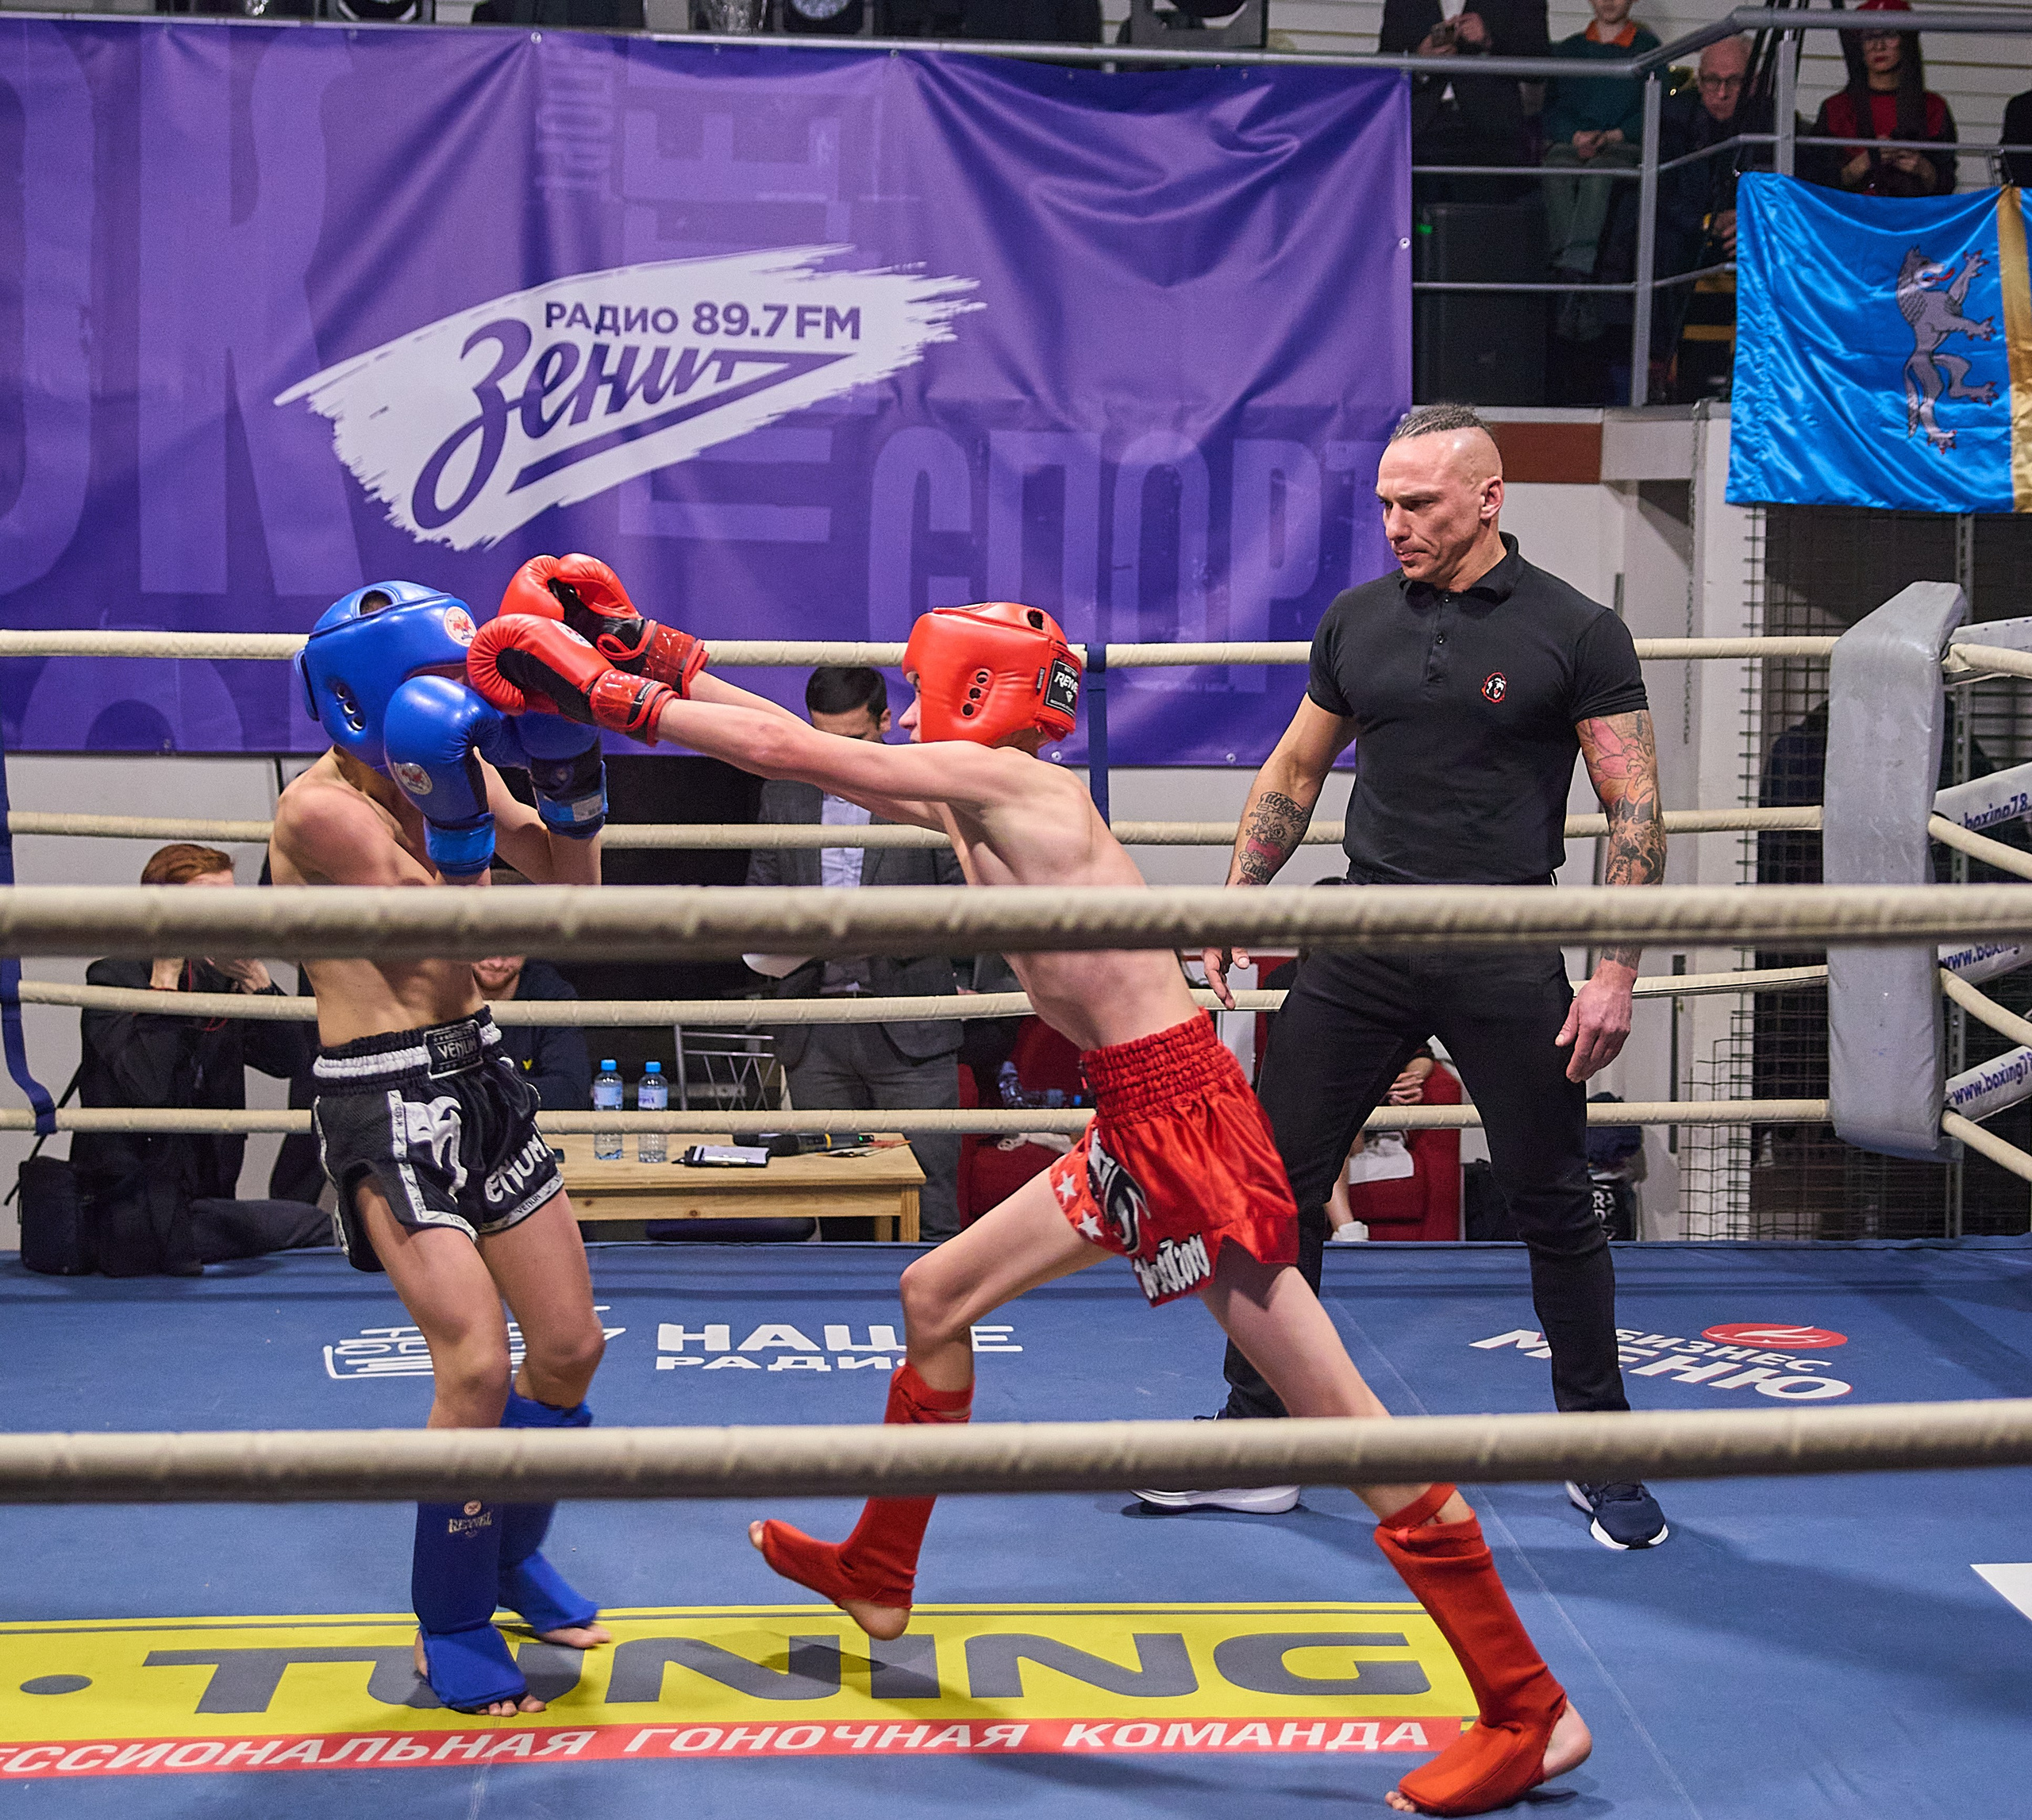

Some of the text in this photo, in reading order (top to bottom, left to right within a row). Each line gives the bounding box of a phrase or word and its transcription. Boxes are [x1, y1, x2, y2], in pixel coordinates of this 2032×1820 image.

[545, 302, 679, 337] РАДИО
[411, 318, 858, 530] Зенит
[437, 1037, 478, 1059] VENUM
[142, 1632, 1432, 1714] TUNING
[624, 1724, 1029, 1759] ГОНОЧНАЯ
[1061, 1722, 1429, 1750] КОМАНДА
